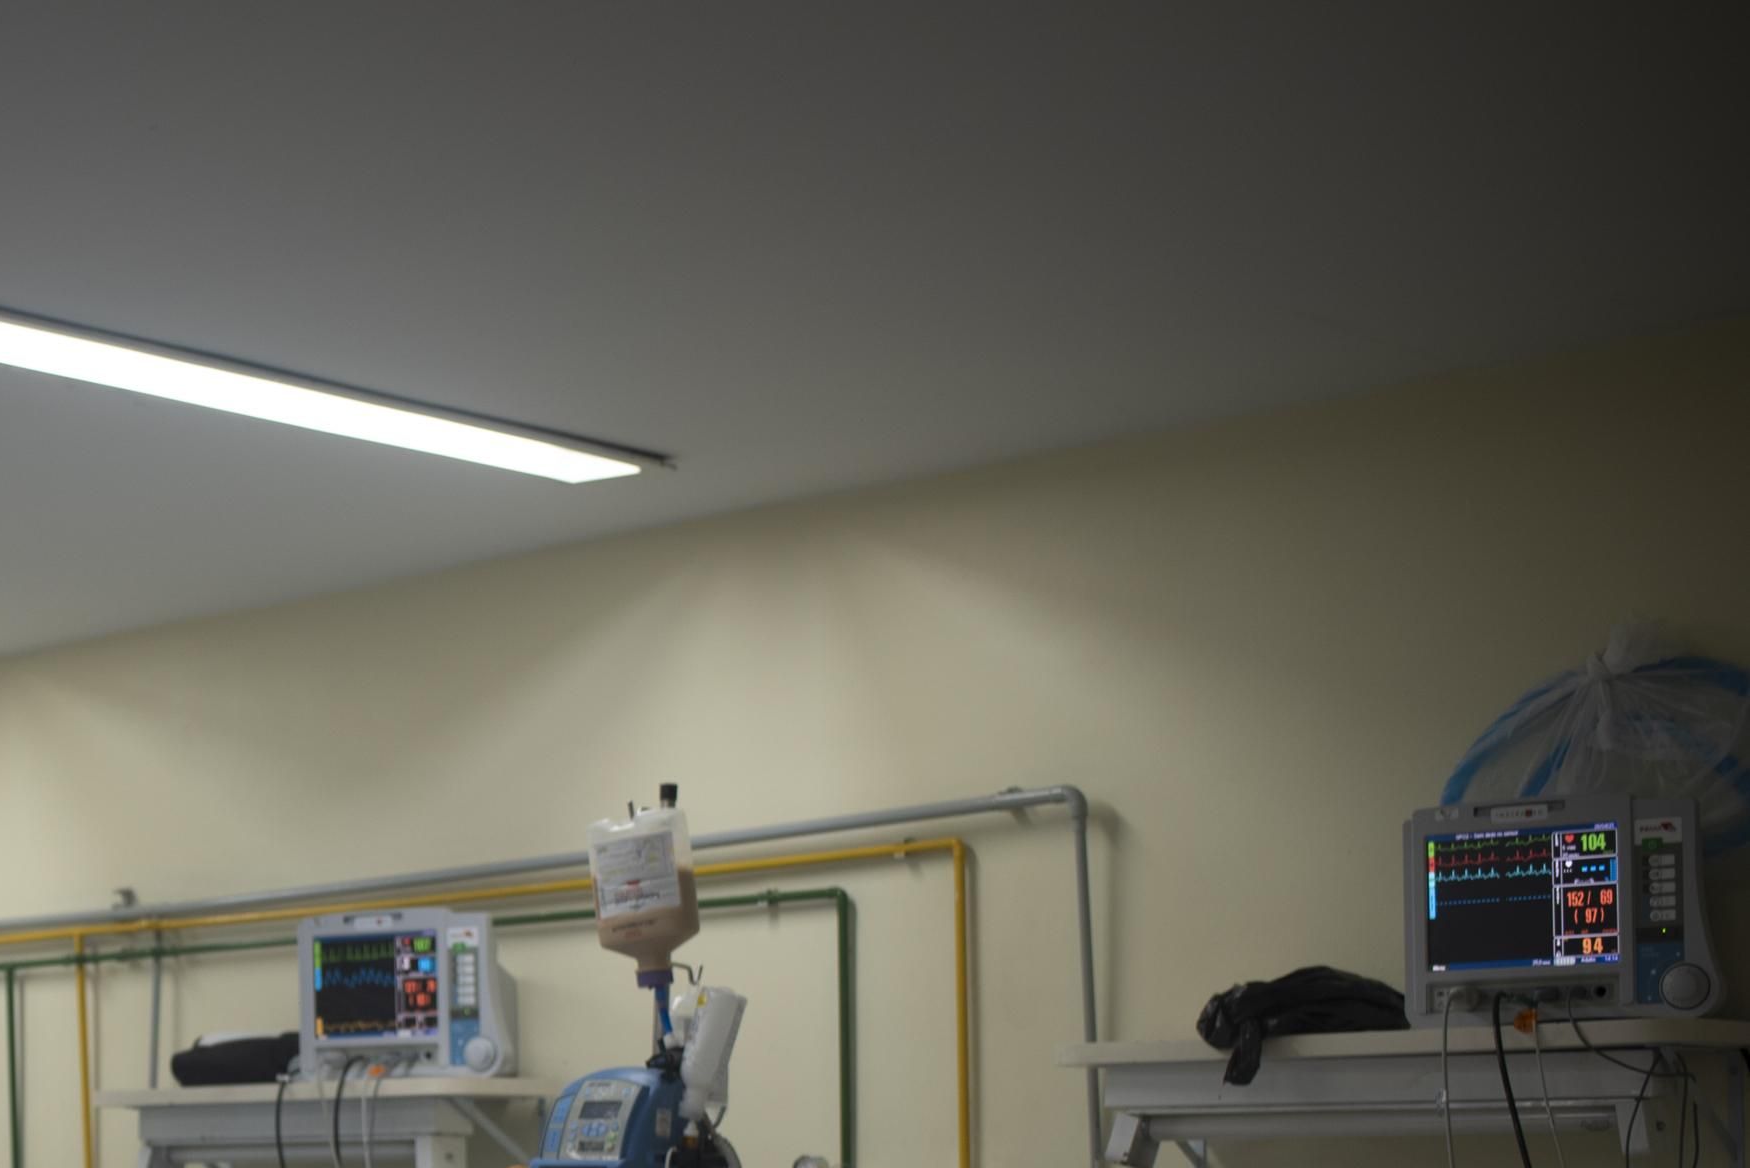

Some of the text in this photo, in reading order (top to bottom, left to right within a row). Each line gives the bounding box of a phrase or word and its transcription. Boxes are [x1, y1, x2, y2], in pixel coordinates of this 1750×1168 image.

[1580, 831, 1606, 852] 104
[1600, 888, 1613, 905] 69
[1582, 936, 1603, 954] 94
